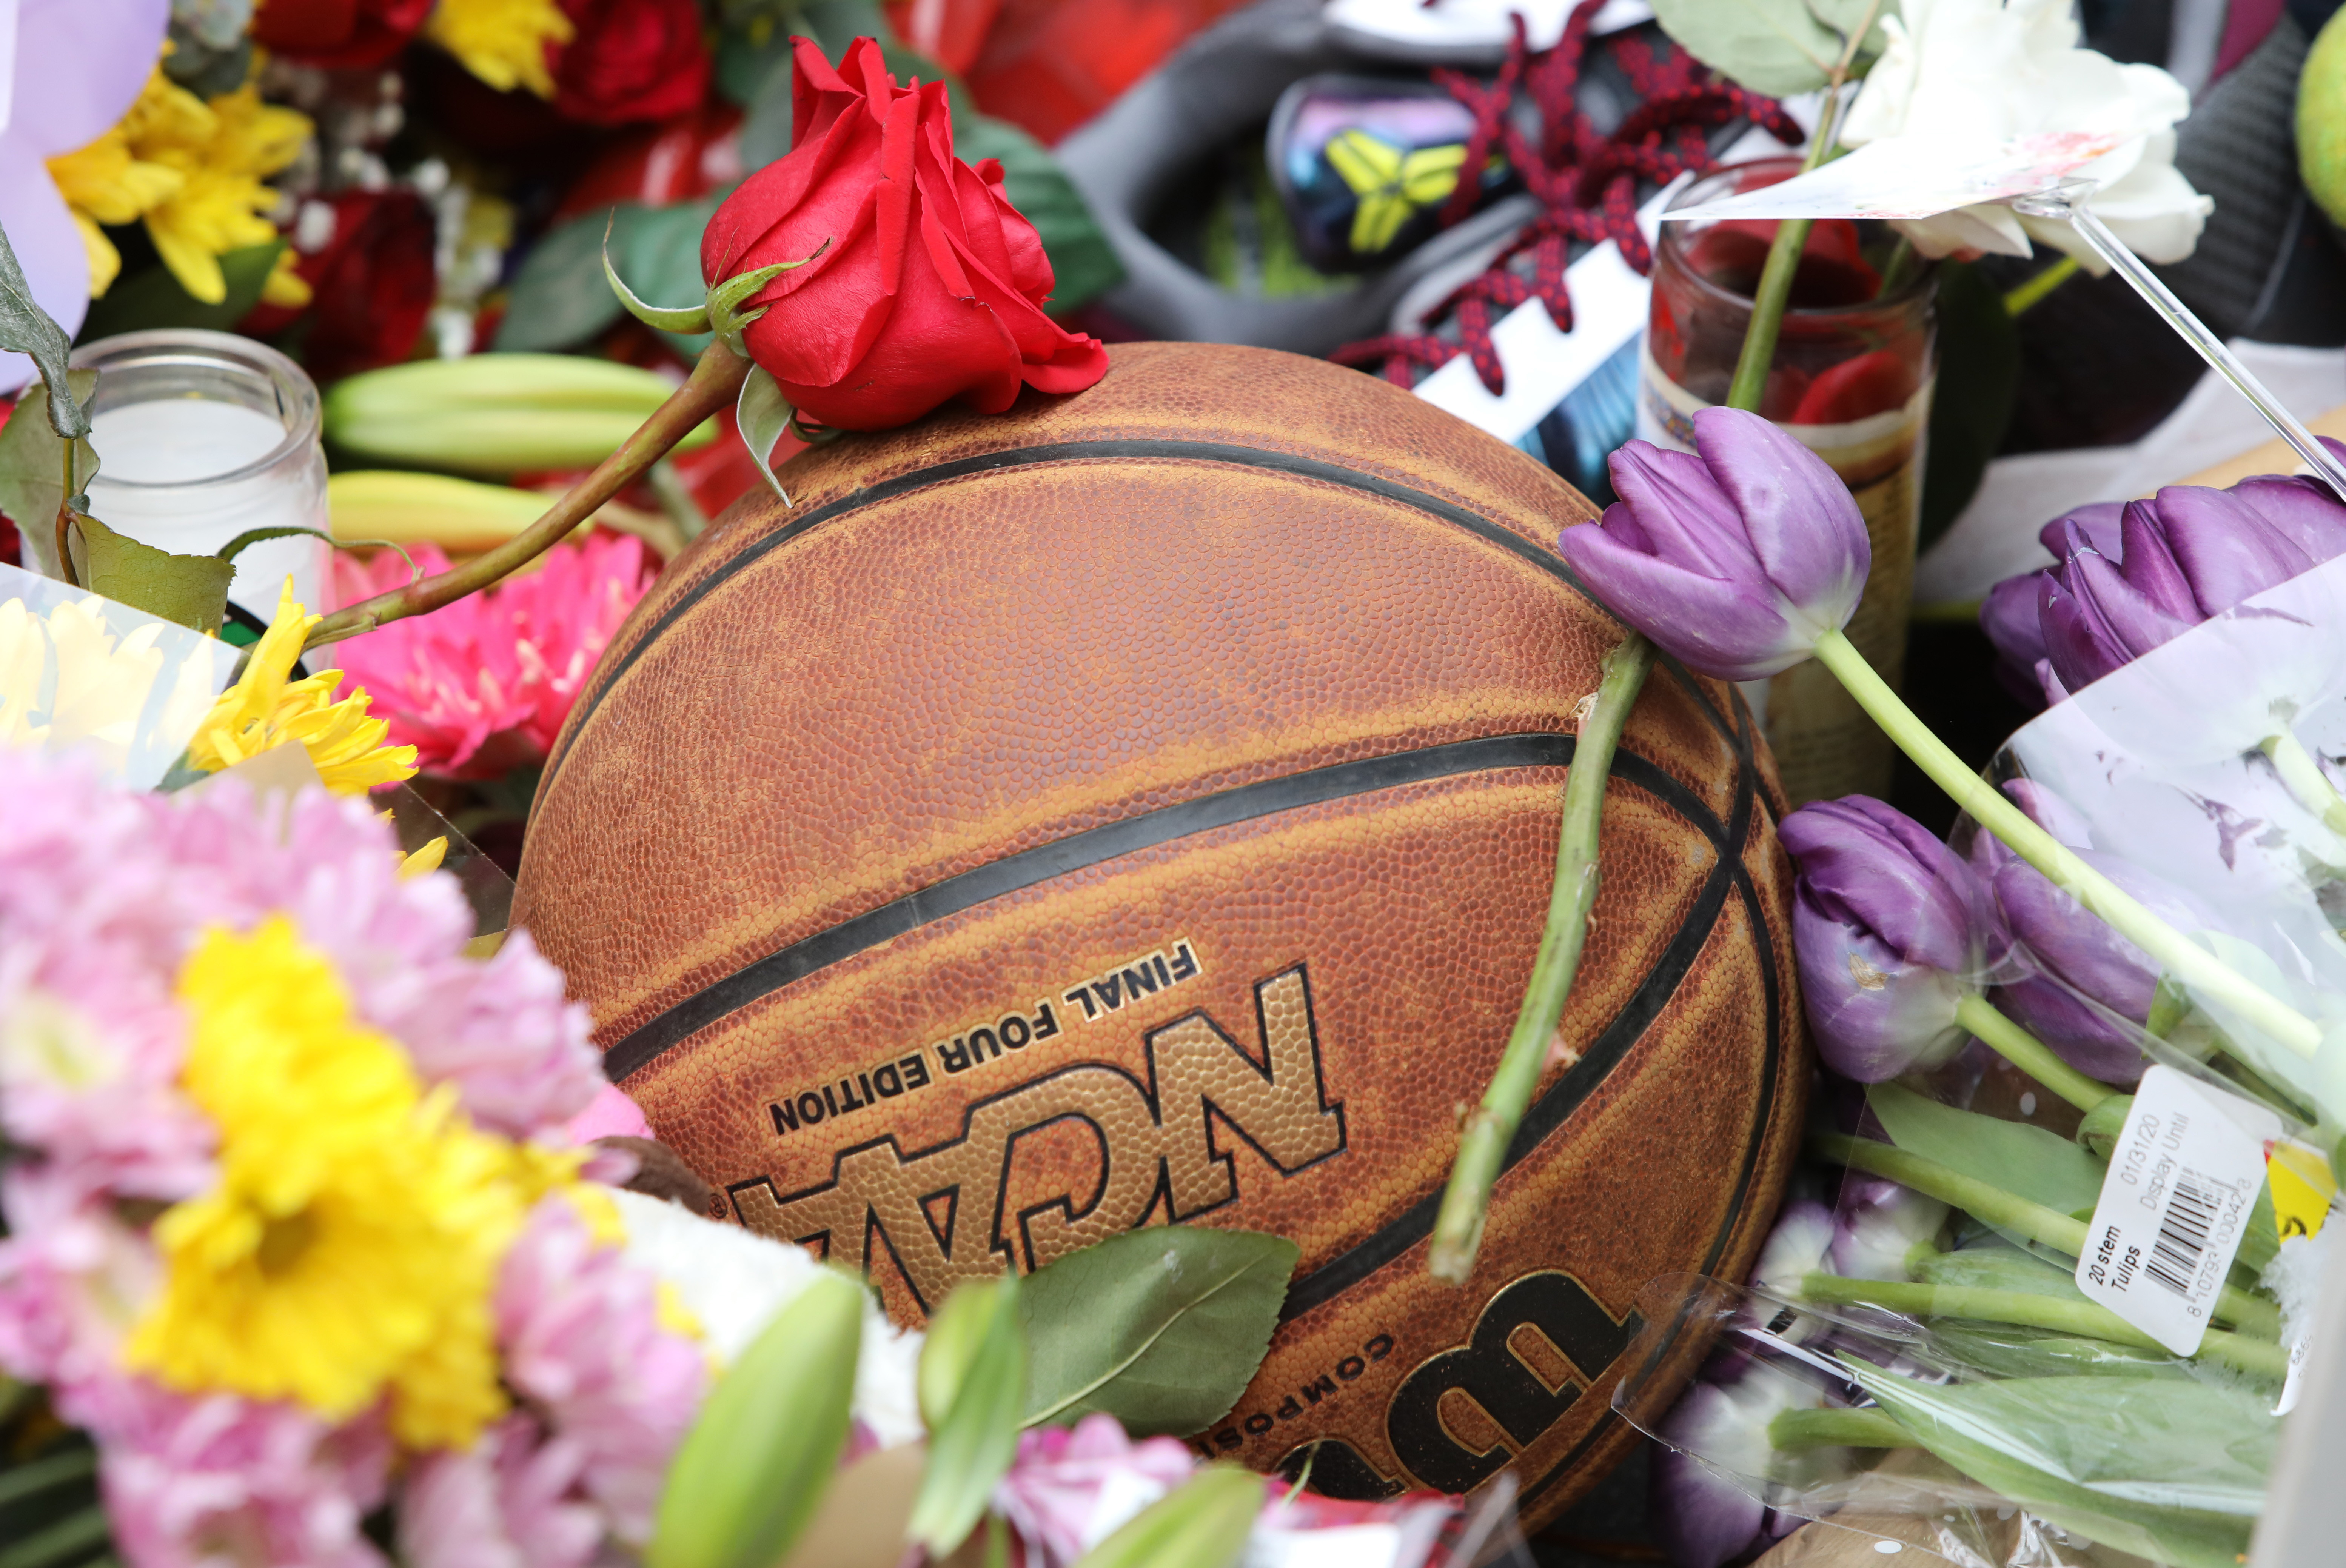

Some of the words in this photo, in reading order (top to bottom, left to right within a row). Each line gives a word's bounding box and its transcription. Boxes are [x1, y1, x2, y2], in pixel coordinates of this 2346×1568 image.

[1064, 937, 1203, 1023] FINAL
[935, 1002, 1061, 1074] FOUR
[770, 1053, 930, 1135] EDITION
[726, 960, 1348, 1317] NCAA
[2120, 1114, 2160, 1186] 01/31/20
[2141, 1153, 2177, 1211] Display
[2166, 1112, 2189, 1153] Until
[2089, 1265, 2105, 1287] 20
[2098, 1226, 2121, 1265] stem
[2111, 1245, 2141, 1292] Tulips
[2187, 1305, 2202, 1317] 8
[2217, 1191, 2246, 1245] 00042
[1200, 1333, 1393, 1457] COMPOSI
